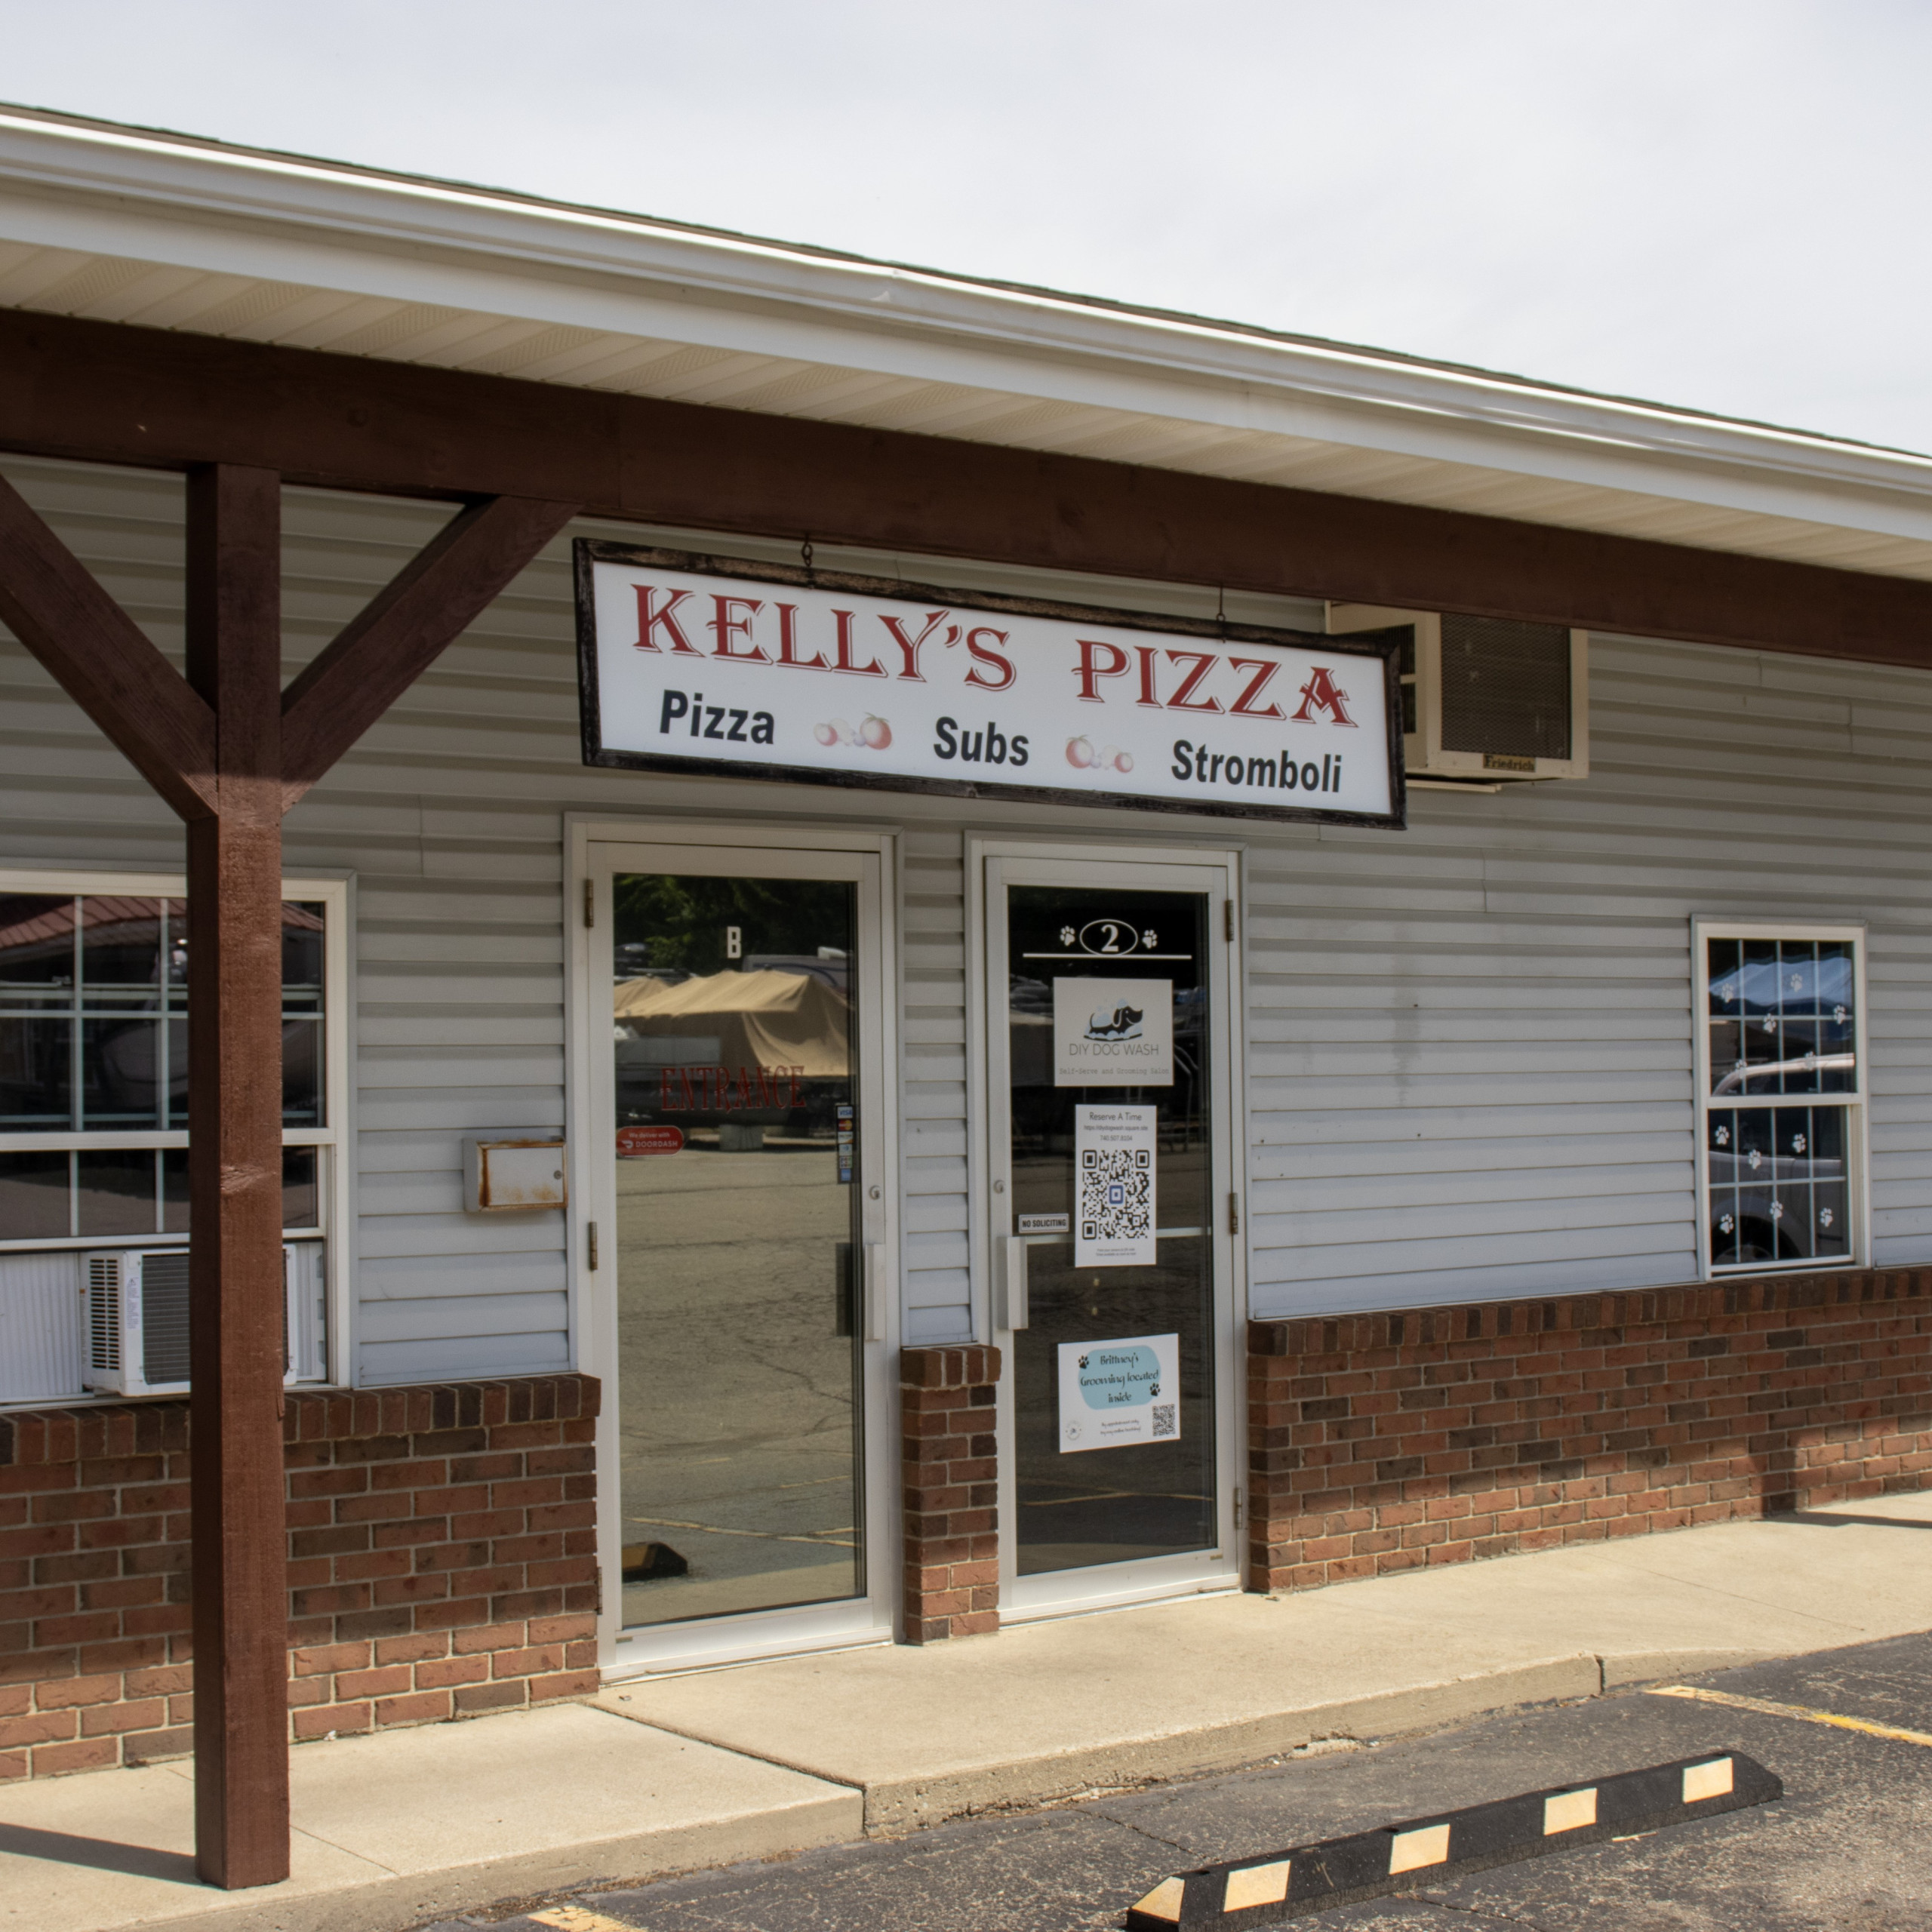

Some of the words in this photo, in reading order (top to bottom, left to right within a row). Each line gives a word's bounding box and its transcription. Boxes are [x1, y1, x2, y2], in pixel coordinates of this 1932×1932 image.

[631, 583, 1016, 690] KELLY'S
[1072, 639, 1358, 728] PIZZA
[660, 689, 774, 745] Pizza
[934, 716, 1029, 767] Subs
[1171, 740, 1341, 793] Stromboli
[1484, 755, 1535, 771] Friedrich
[727, 926, 741, 958] B
[1101, 924, 1119, 952] 2
[1069, 1043, 1090, 1056] DIY
[1093, 1043, 1121, 1056] DOG
[1123, 1043, 1159, 1056] WASH
[660, 1065, 807, 1113] ENTRANCE
[1089, 1112, 1116, 1121] Reserve
[1118, 1112, 1123, 1121] A
[1125, 1112, 1142, 1121] Time
[1022, 1220, 1031, 1228] NO
[1032, 1219, 1066, 1227] SOLICITING
[1080, 1374, 1125, 1389] Grooming
[1127, 1369, 1159, 1381] located
[1108, 1392, 1132, 1403] inside
